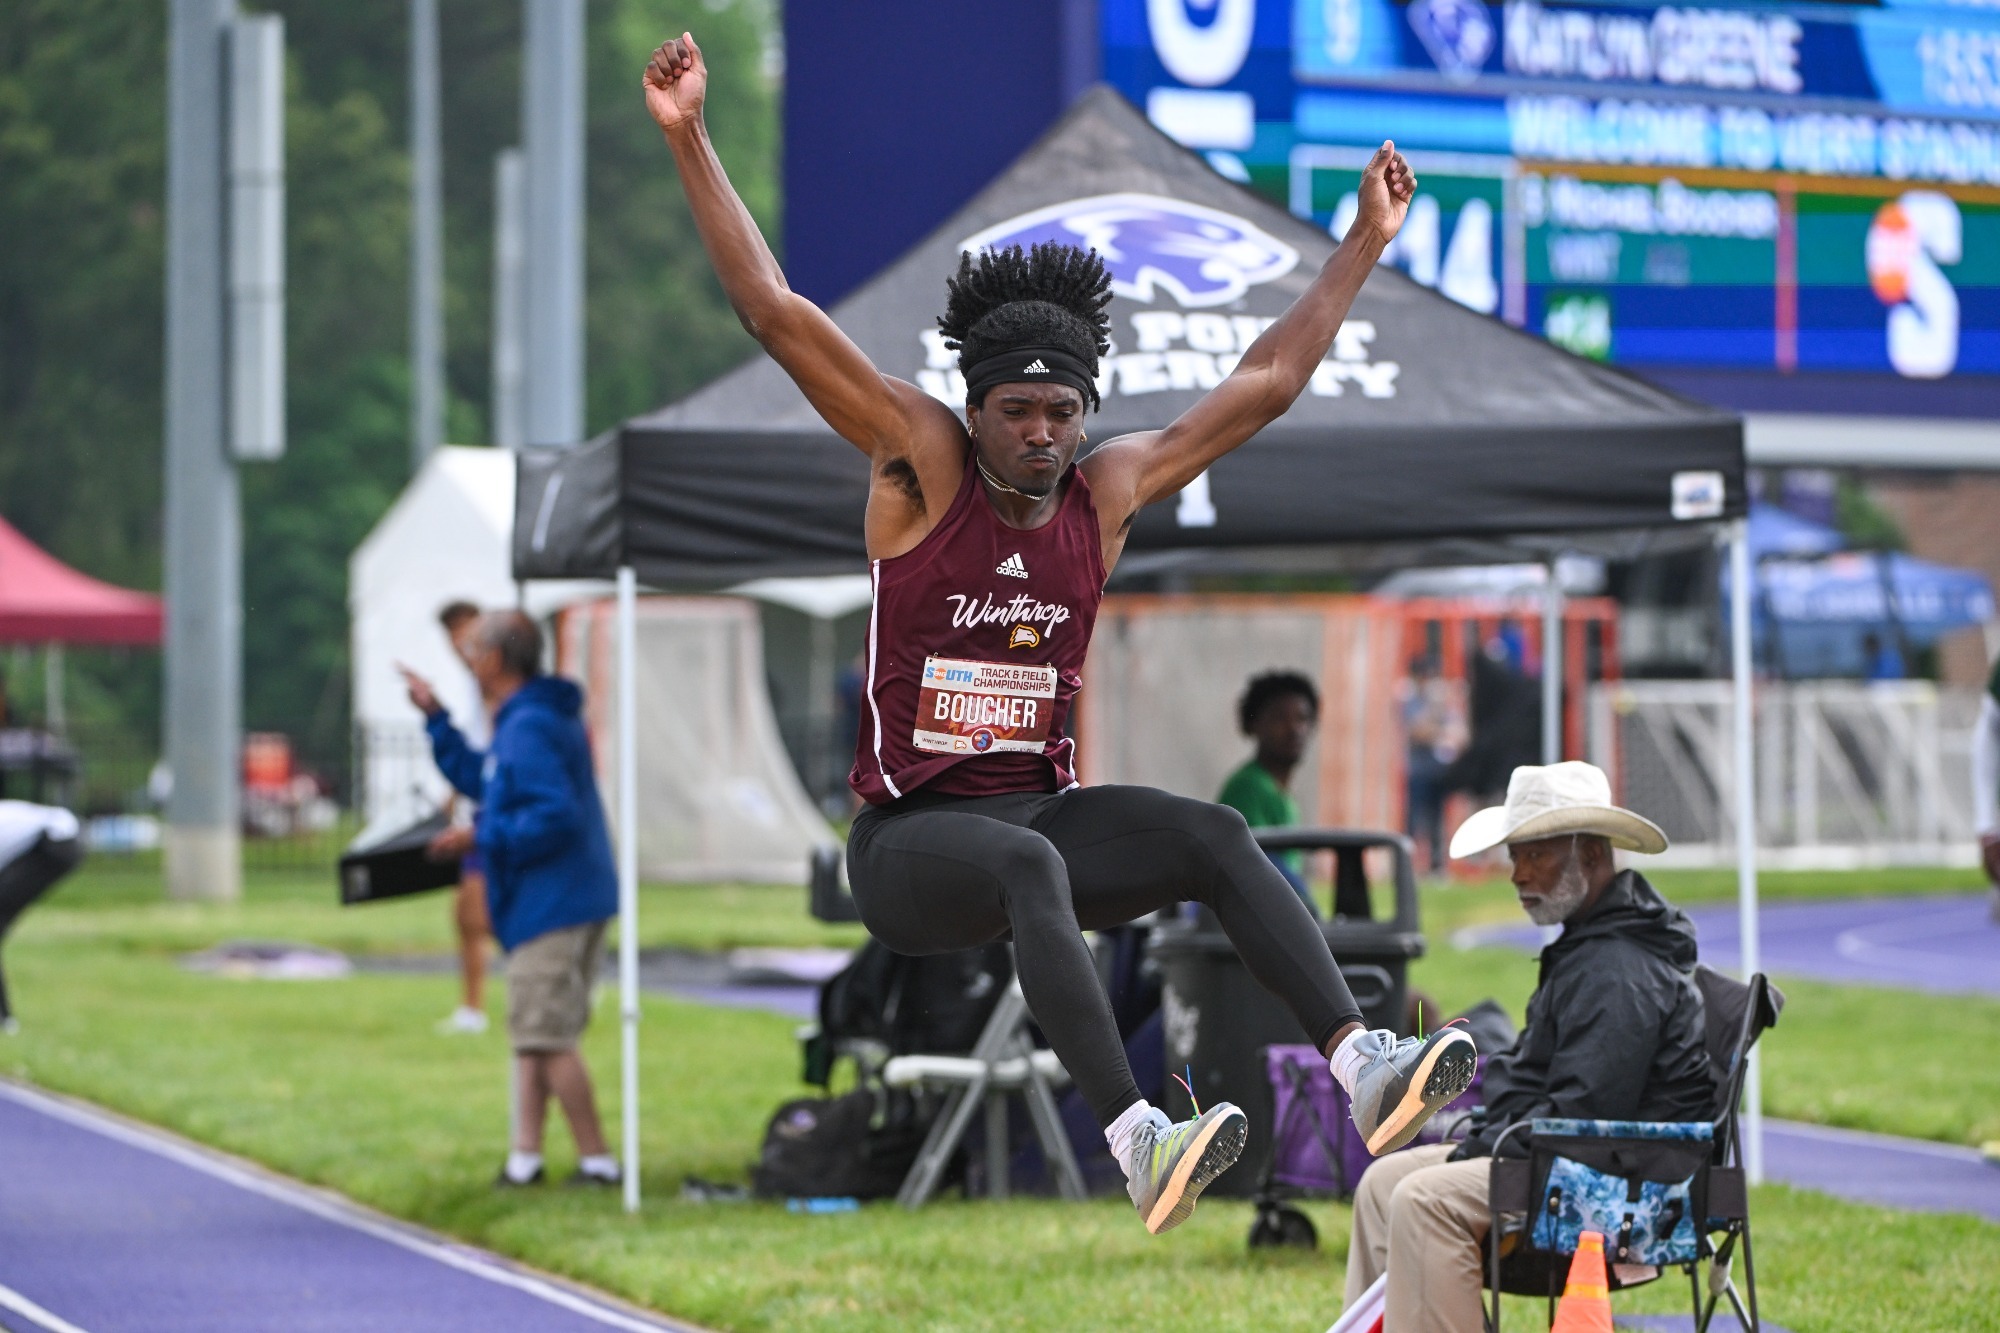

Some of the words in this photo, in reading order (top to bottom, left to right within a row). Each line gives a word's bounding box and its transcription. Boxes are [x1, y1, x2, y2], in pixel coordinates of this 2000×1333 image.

[996, 566, 1029, 579] adidas
[946, 591, 1071, 639] Winthrop
[980, 667, 1010, 679] TRACK
[1012, 669, 1020, 679] &
[1021, 670, 1048, 682] FIELD
[973, 677, 1051, 692] CHAMPIONSHIPS
[934, 691, 1037, 728] BOUCHER
